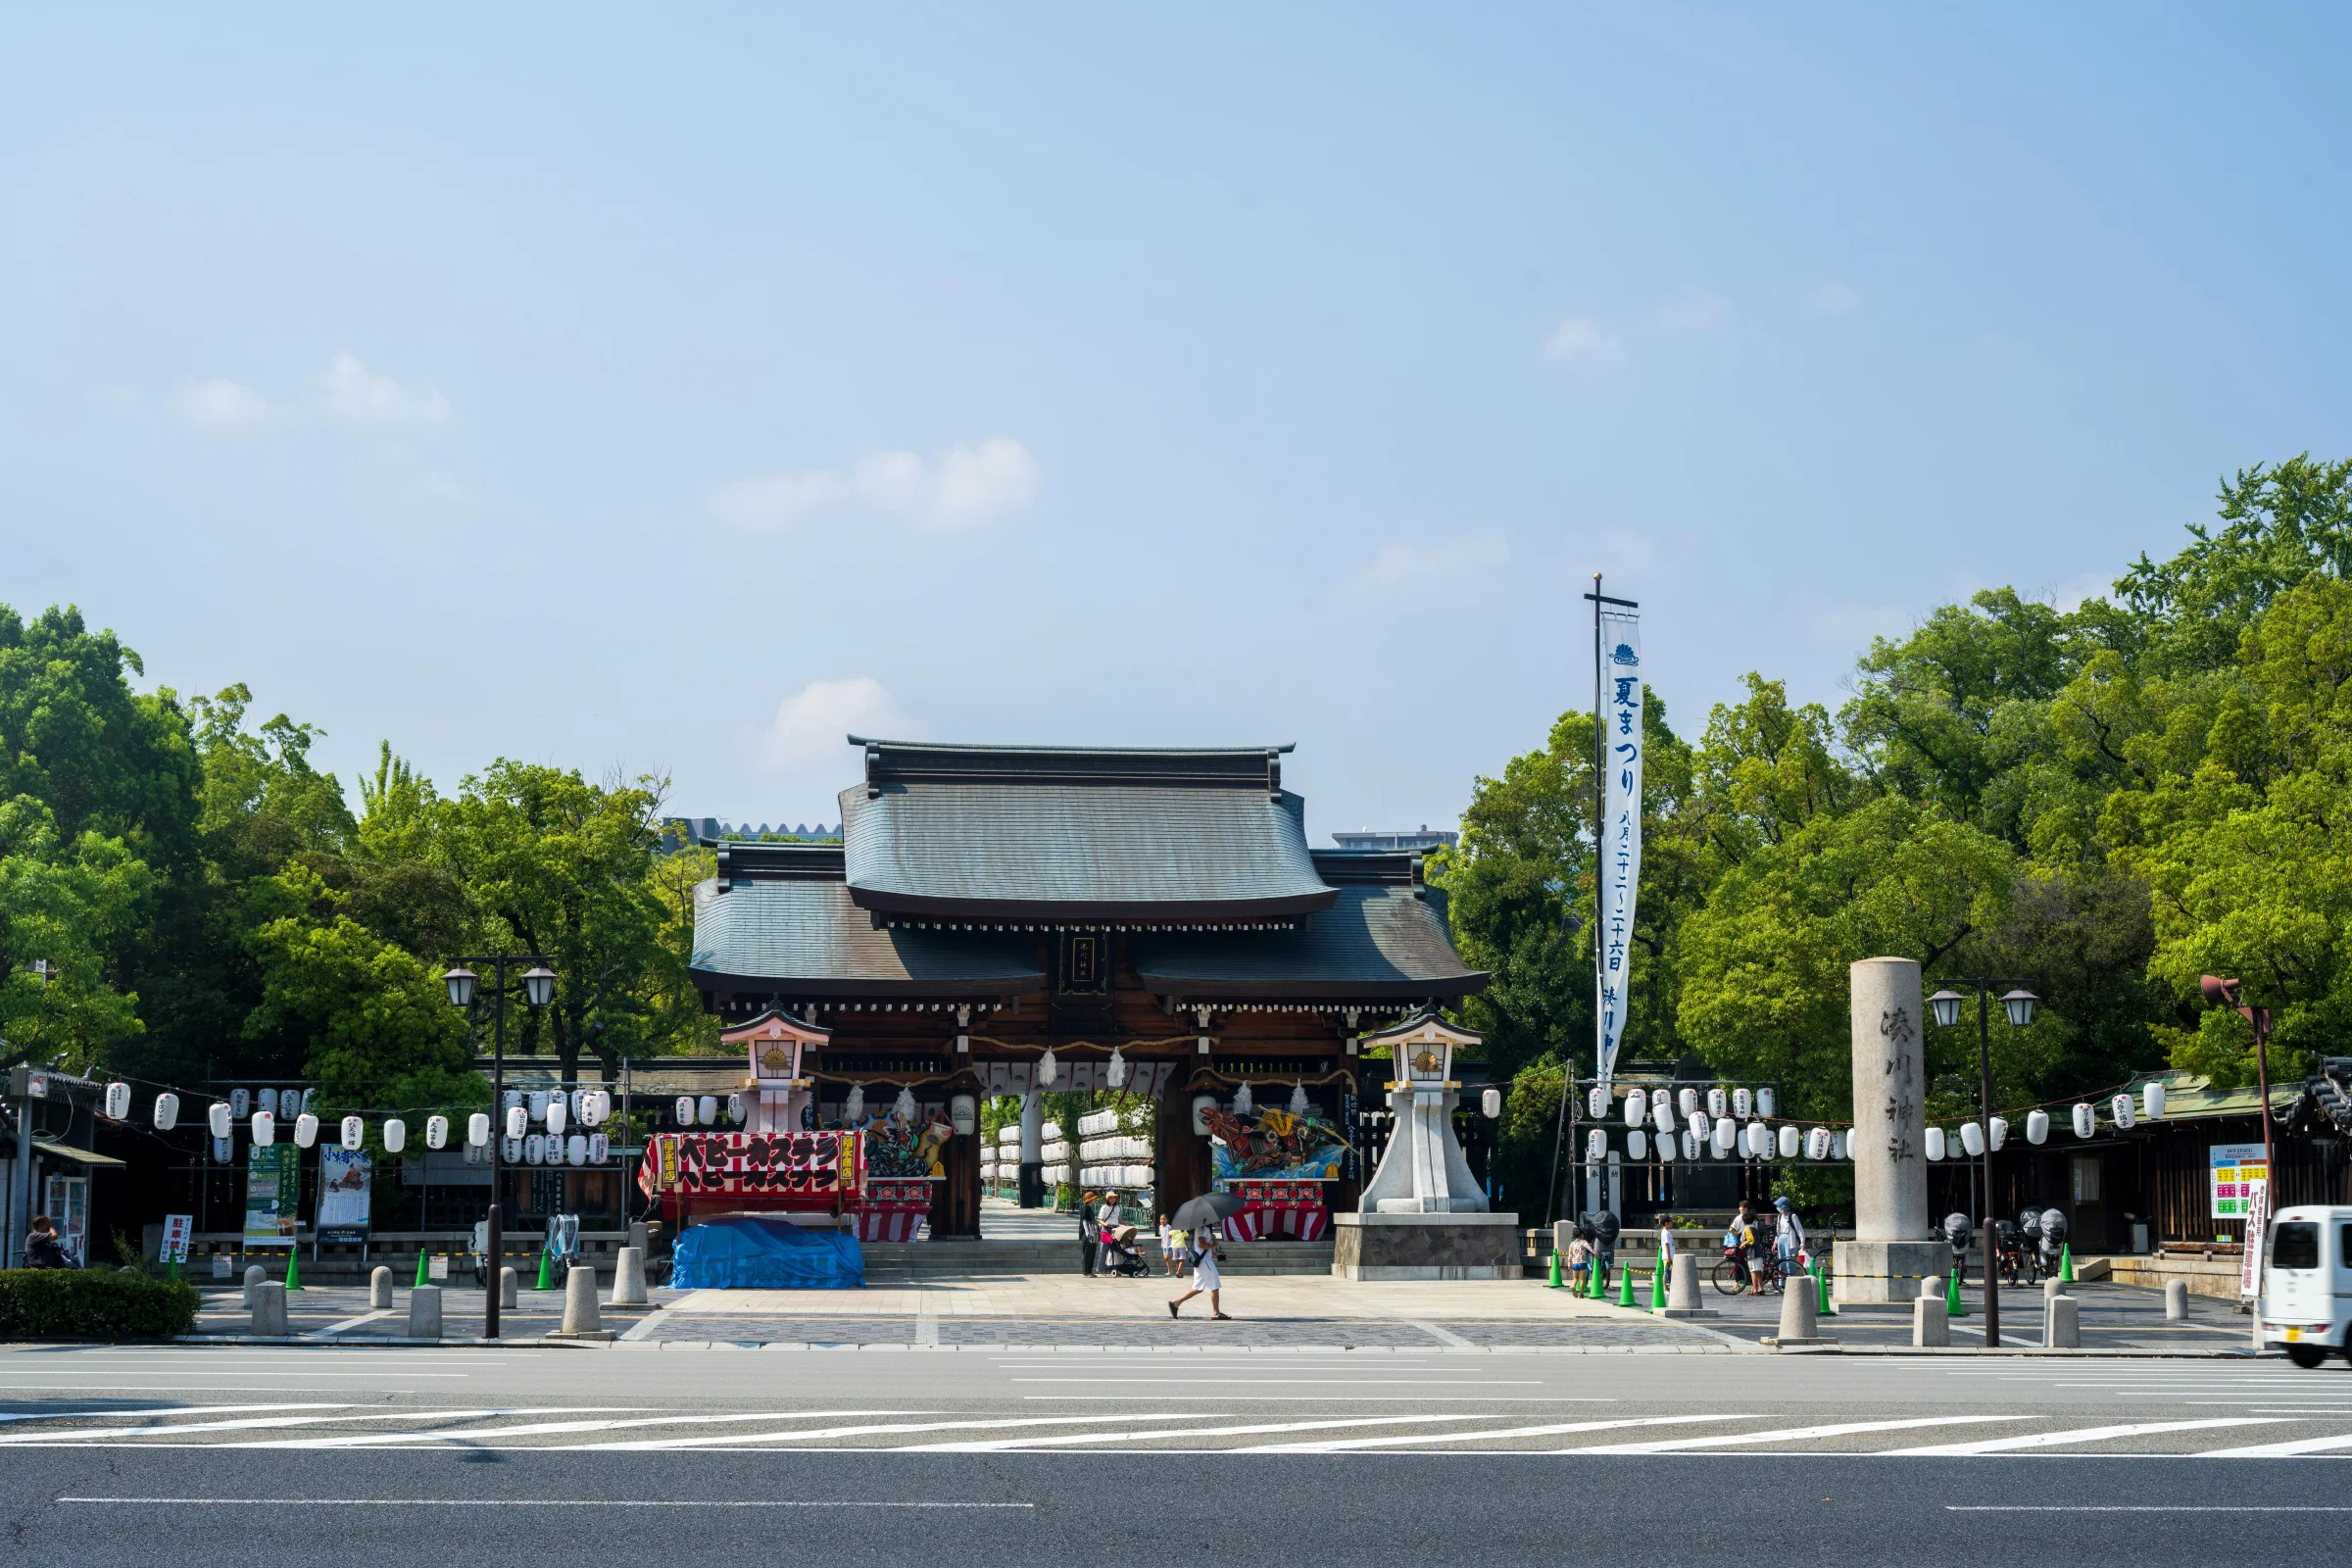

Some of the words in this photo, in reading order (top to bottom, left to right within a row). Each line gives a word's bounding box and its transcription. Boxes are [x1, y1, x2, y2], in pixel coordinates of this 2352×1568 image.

[1613, 676, 1641, 799] 夏まつり
[1607, 809, 1631, 972] 八月二十二〜二十六日
[1880, 1006, 1914, 1164] 湊川神社
[280, 1149, 291, 1209] 納涼ビアガーデン
[679, 1136, 839, 1168] ベビーカステラ
[2242, 1191, 2259, 1290] バス駐車場
